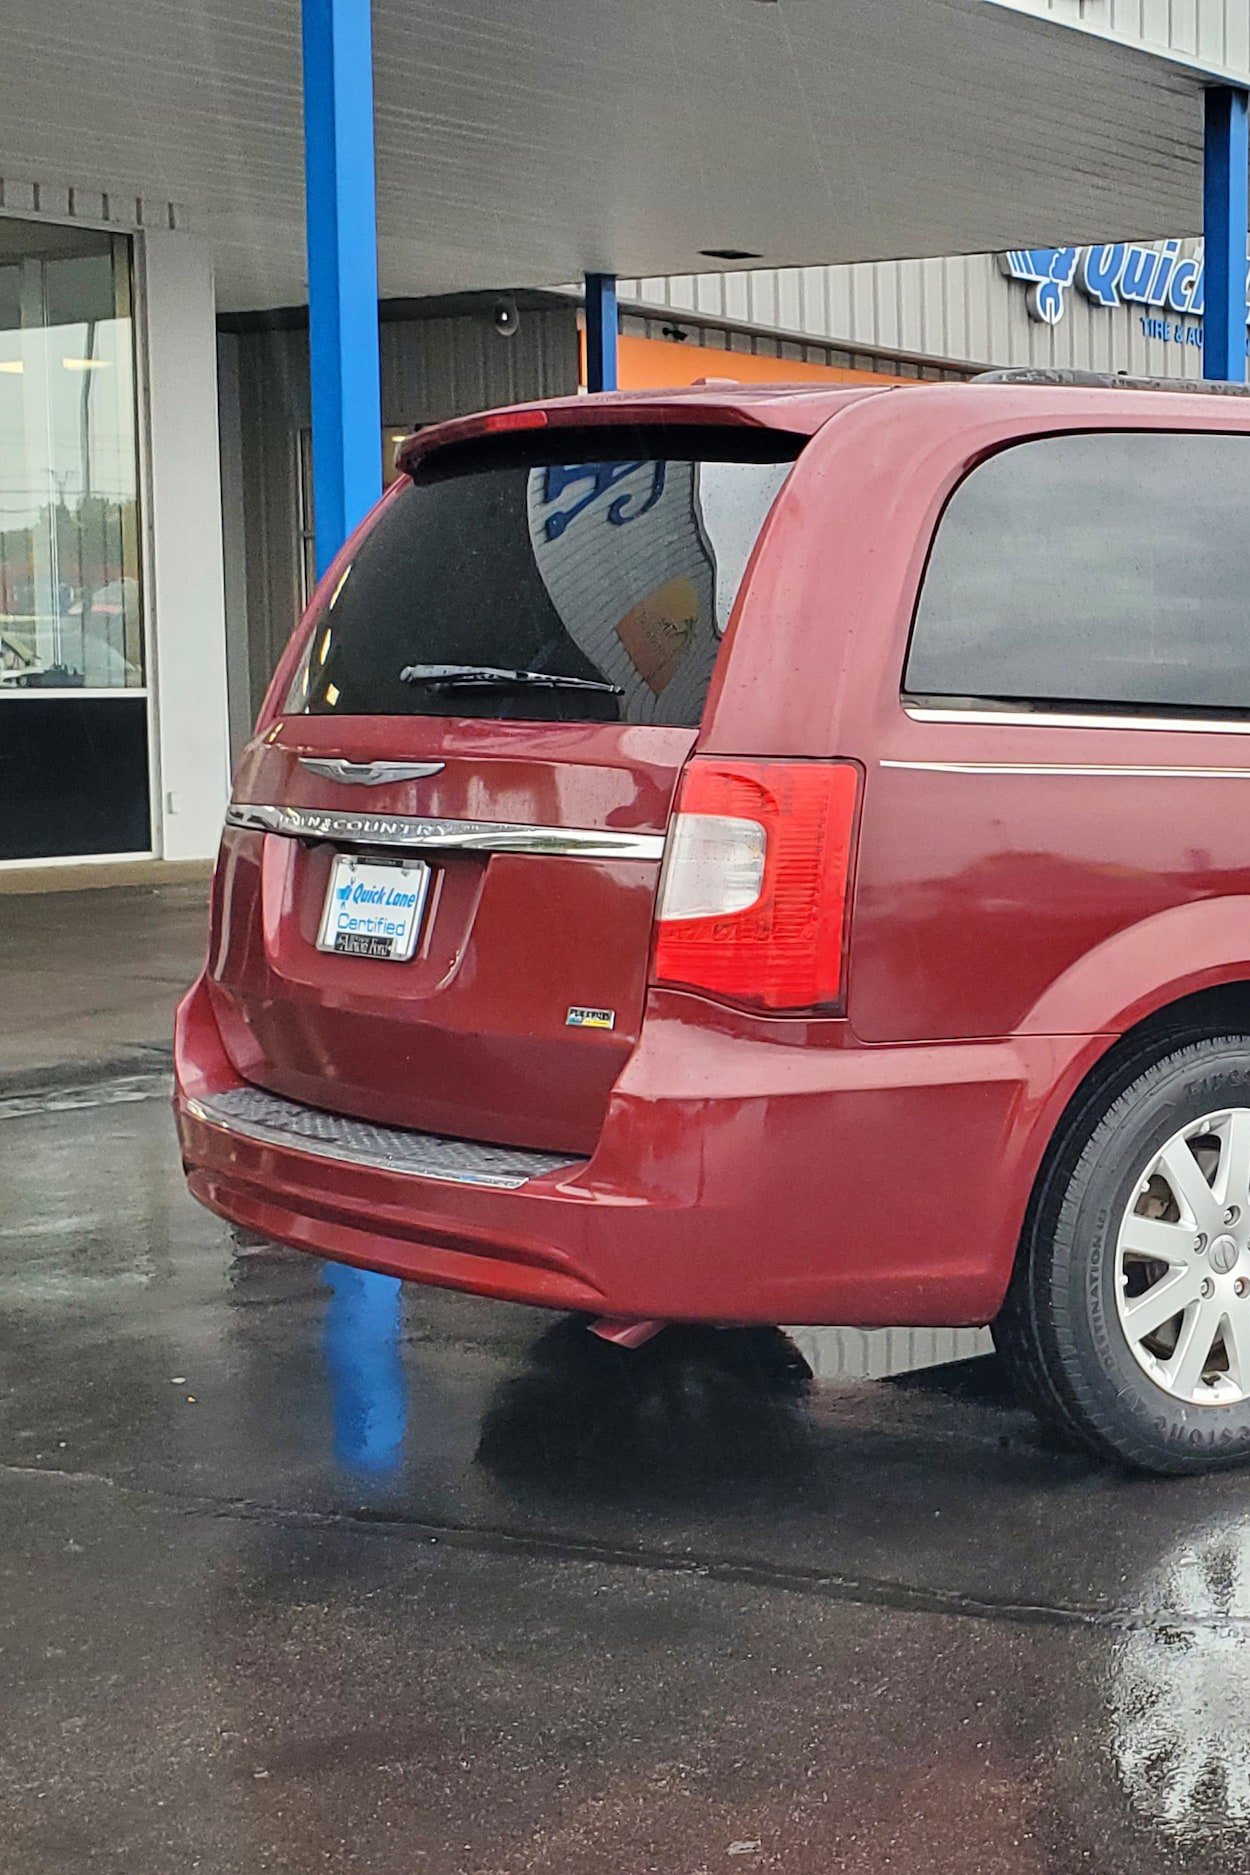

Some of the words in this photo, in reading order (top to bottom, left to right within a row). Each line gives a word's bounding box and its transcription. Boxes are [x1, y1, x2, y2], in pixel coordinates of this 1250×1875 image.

[1139, 317, 1171, 342] TIRE
[1174, 324, 1183, 344] &
[1186, 327, 1203, 350] AU
[352, 883, 386, 905] Quick
[385, 887, 416, 909] Lane
[337, 912, 406, 937] Certified
